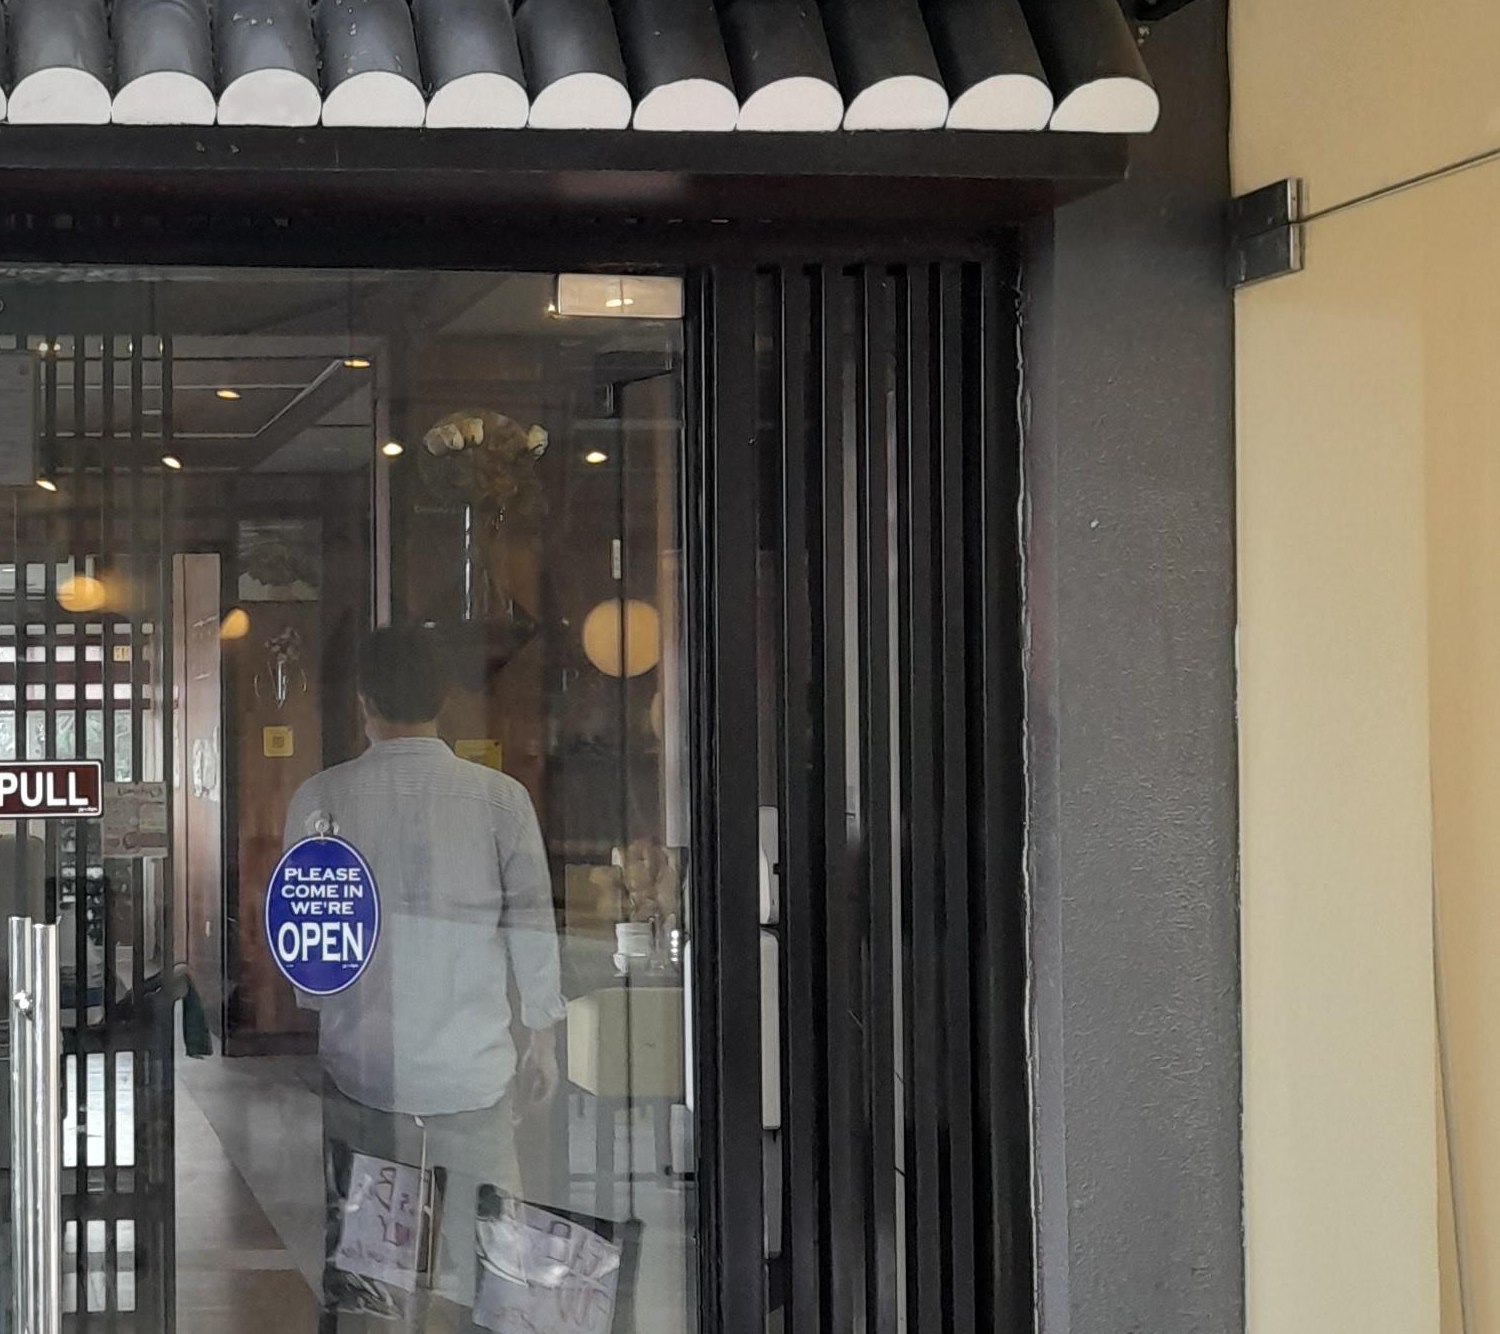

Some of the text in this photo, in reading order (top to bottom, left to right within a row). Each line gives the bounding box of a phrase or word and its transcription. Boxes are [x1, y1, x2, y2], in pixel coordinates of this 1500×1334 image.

[284, 867, 361, 881] PLEASE
[281, 884, 363, 898] COME IN
[290, 901, 354, 915] WE'RE
[278, 921, 364, 963] OPEN
